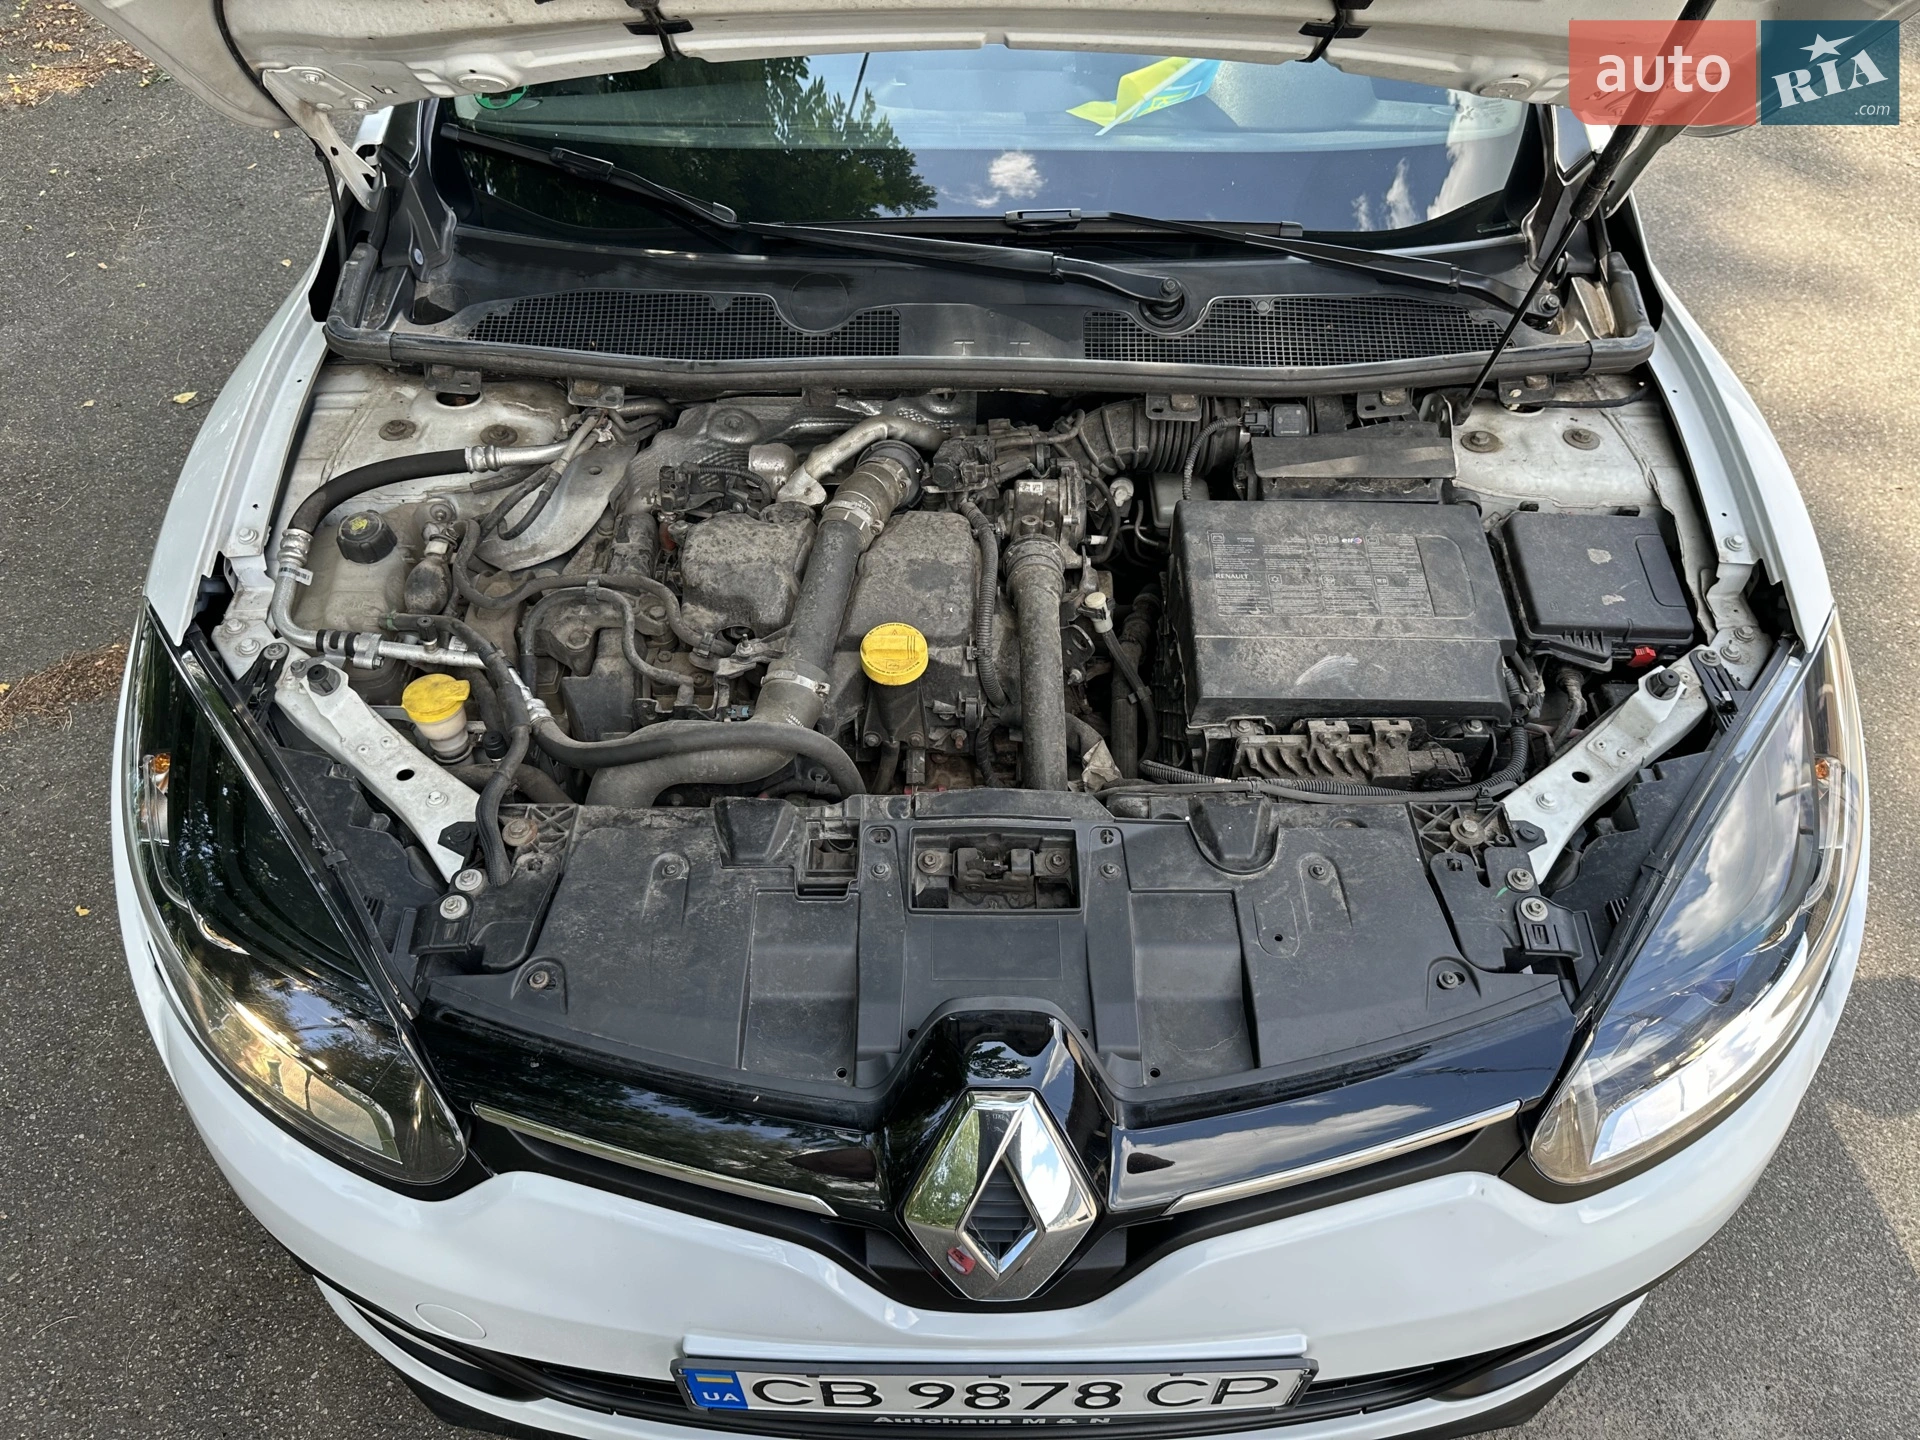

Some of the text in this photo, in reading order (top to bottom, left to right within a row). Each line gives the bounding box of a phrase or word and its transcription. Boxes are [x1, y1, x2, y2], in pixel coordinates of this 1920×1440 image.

[703, 1391, 741, 1402] UA
[752, 1376, 1279, 1410] CB 9878 CP
[873, 1416, 1012, 1425] Autohaus
[1089, 1417, 1111, 1425] N
